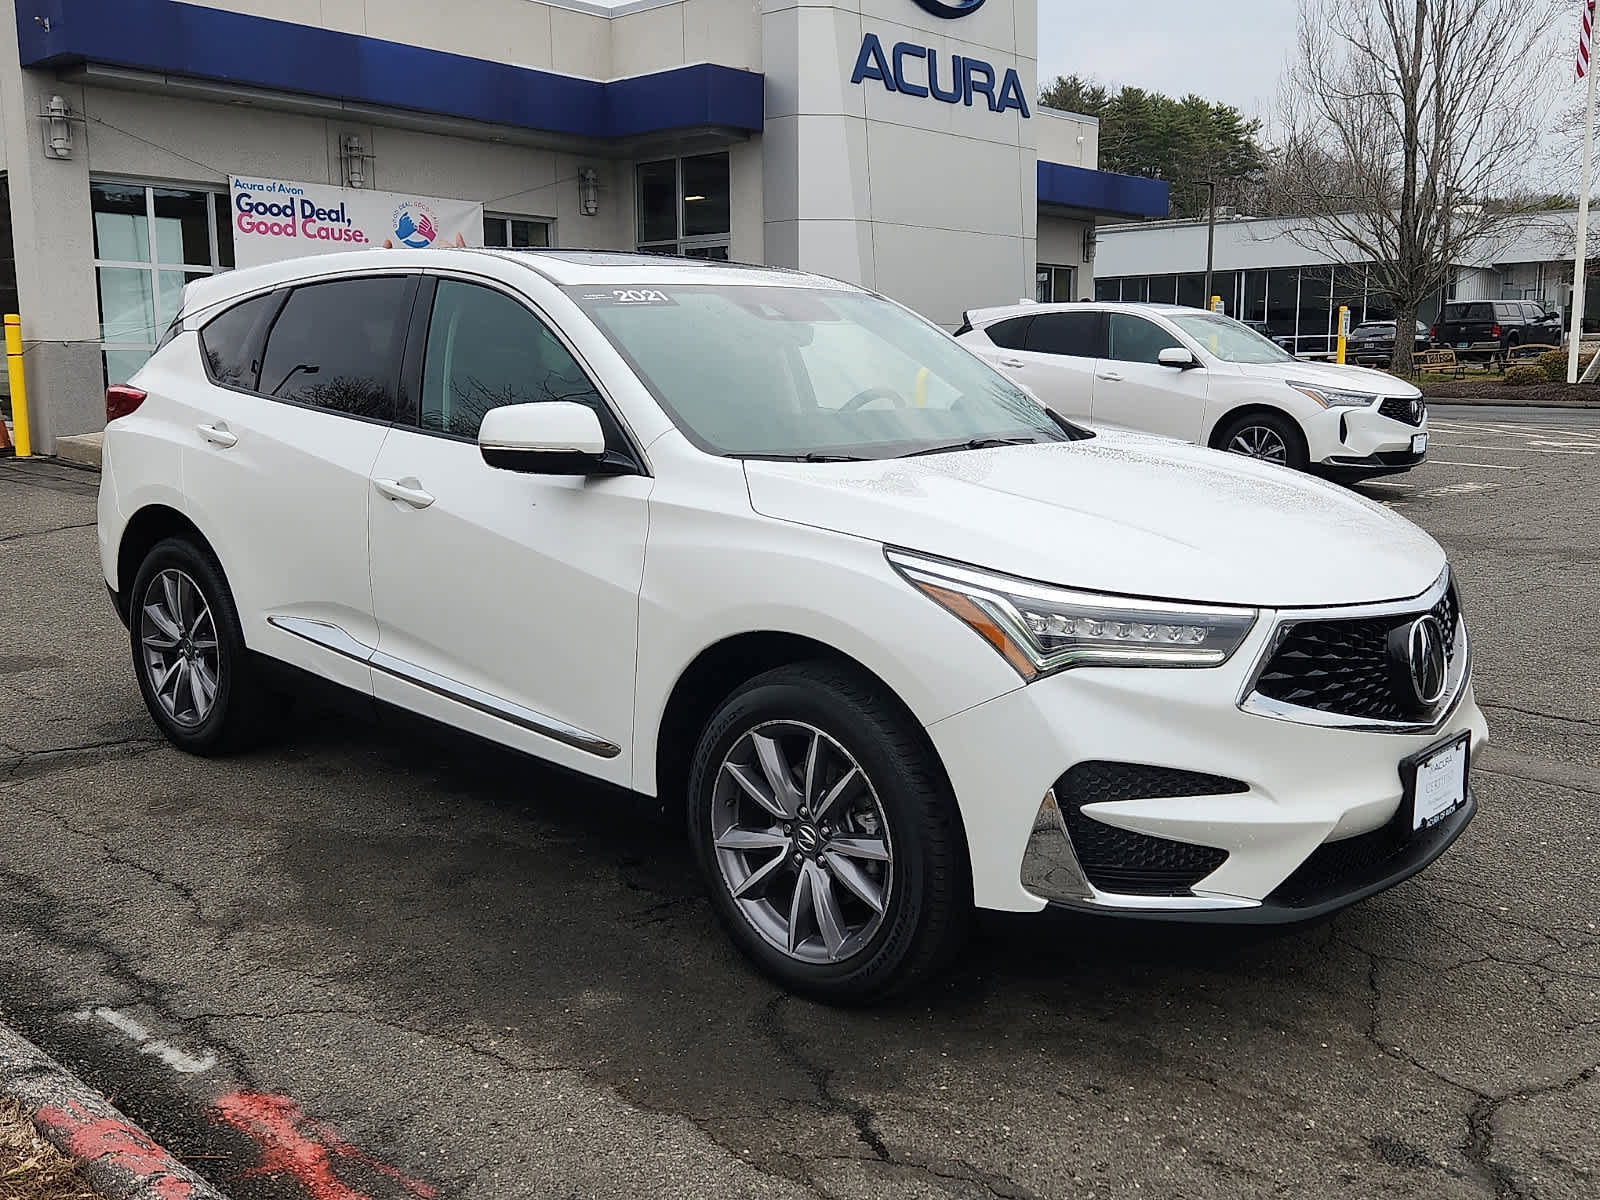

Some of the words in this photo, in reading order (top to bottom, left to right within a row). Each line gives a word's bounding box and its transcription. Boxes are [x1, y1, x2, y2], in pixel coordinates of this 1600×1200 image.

[850, 32, 1030, 118] ACURA
[234, 178, 264, 191] Acura
[266, 182, 276, 192] of
[278, 183, 304, 195] Avon
[235, 192, 296, 218] Good
[300, 198, 352, 227] Deal,
[237, 211, 297, 237] Good
[301, 218, 369, 243] Cause.
[612, 289, 669, 301] 2021
